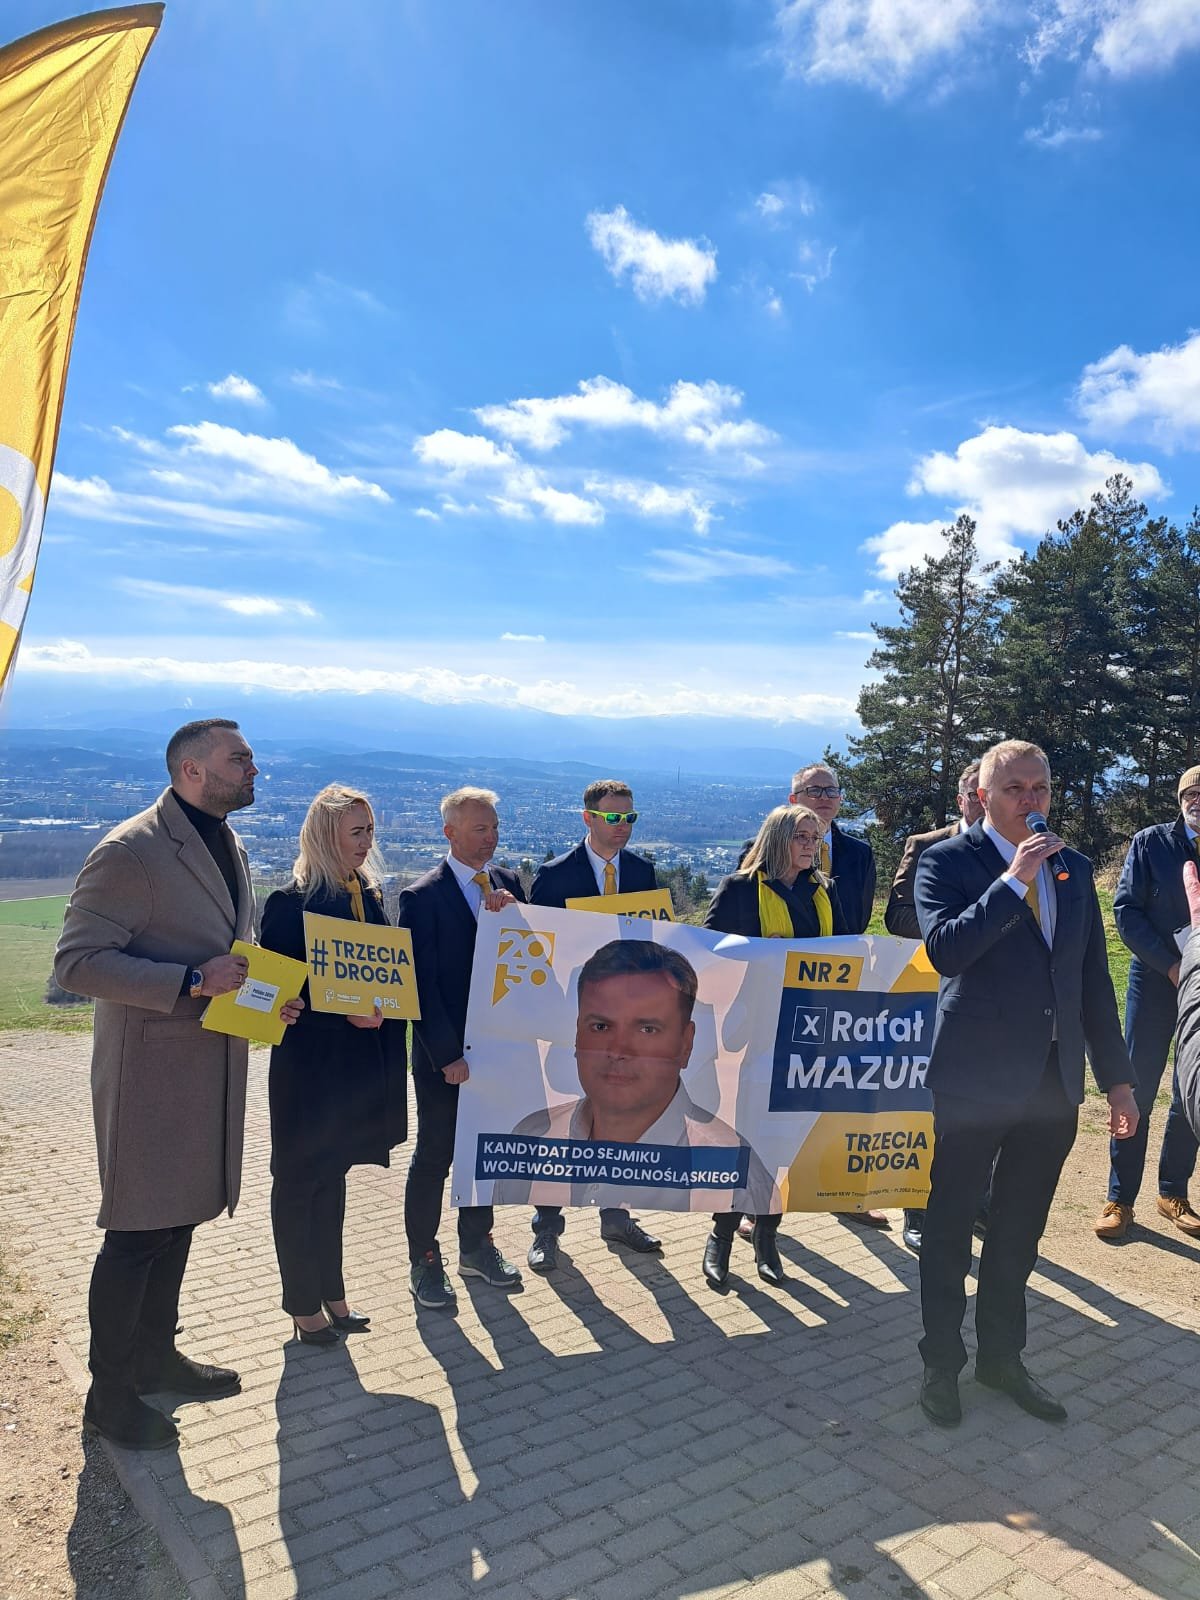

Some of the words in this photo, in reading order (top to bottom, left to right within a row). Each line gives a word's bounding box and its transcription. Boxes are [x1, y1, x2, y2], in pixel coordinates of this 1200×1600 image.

[331, 939, 410, 966] TRZECIA
[334, 961, 403, 986] DROGA
[798, 960, 832, 982] NR
[836, 963, 851, 983] 2
[383, 997, 401, 1009] PSL
[831, 1008, 924, 1042] Rafał
[786, 1053, 930, 1091] MAZUR
[483, 1141, 569, 1159] KANDYDAT
[572, 1147, 594, 1159] DO
[597, 1147, 661, 1164] SEJMIKU
[845, 1131, 928, 1152] TRZECIA
[482, 1160, 608, 1178] WOJEWÓDZTWA
[611, 1167, 740, 1186] DOLNOŚLĄSKIEGO
[847, 1152, 920, 1173] DROGA
